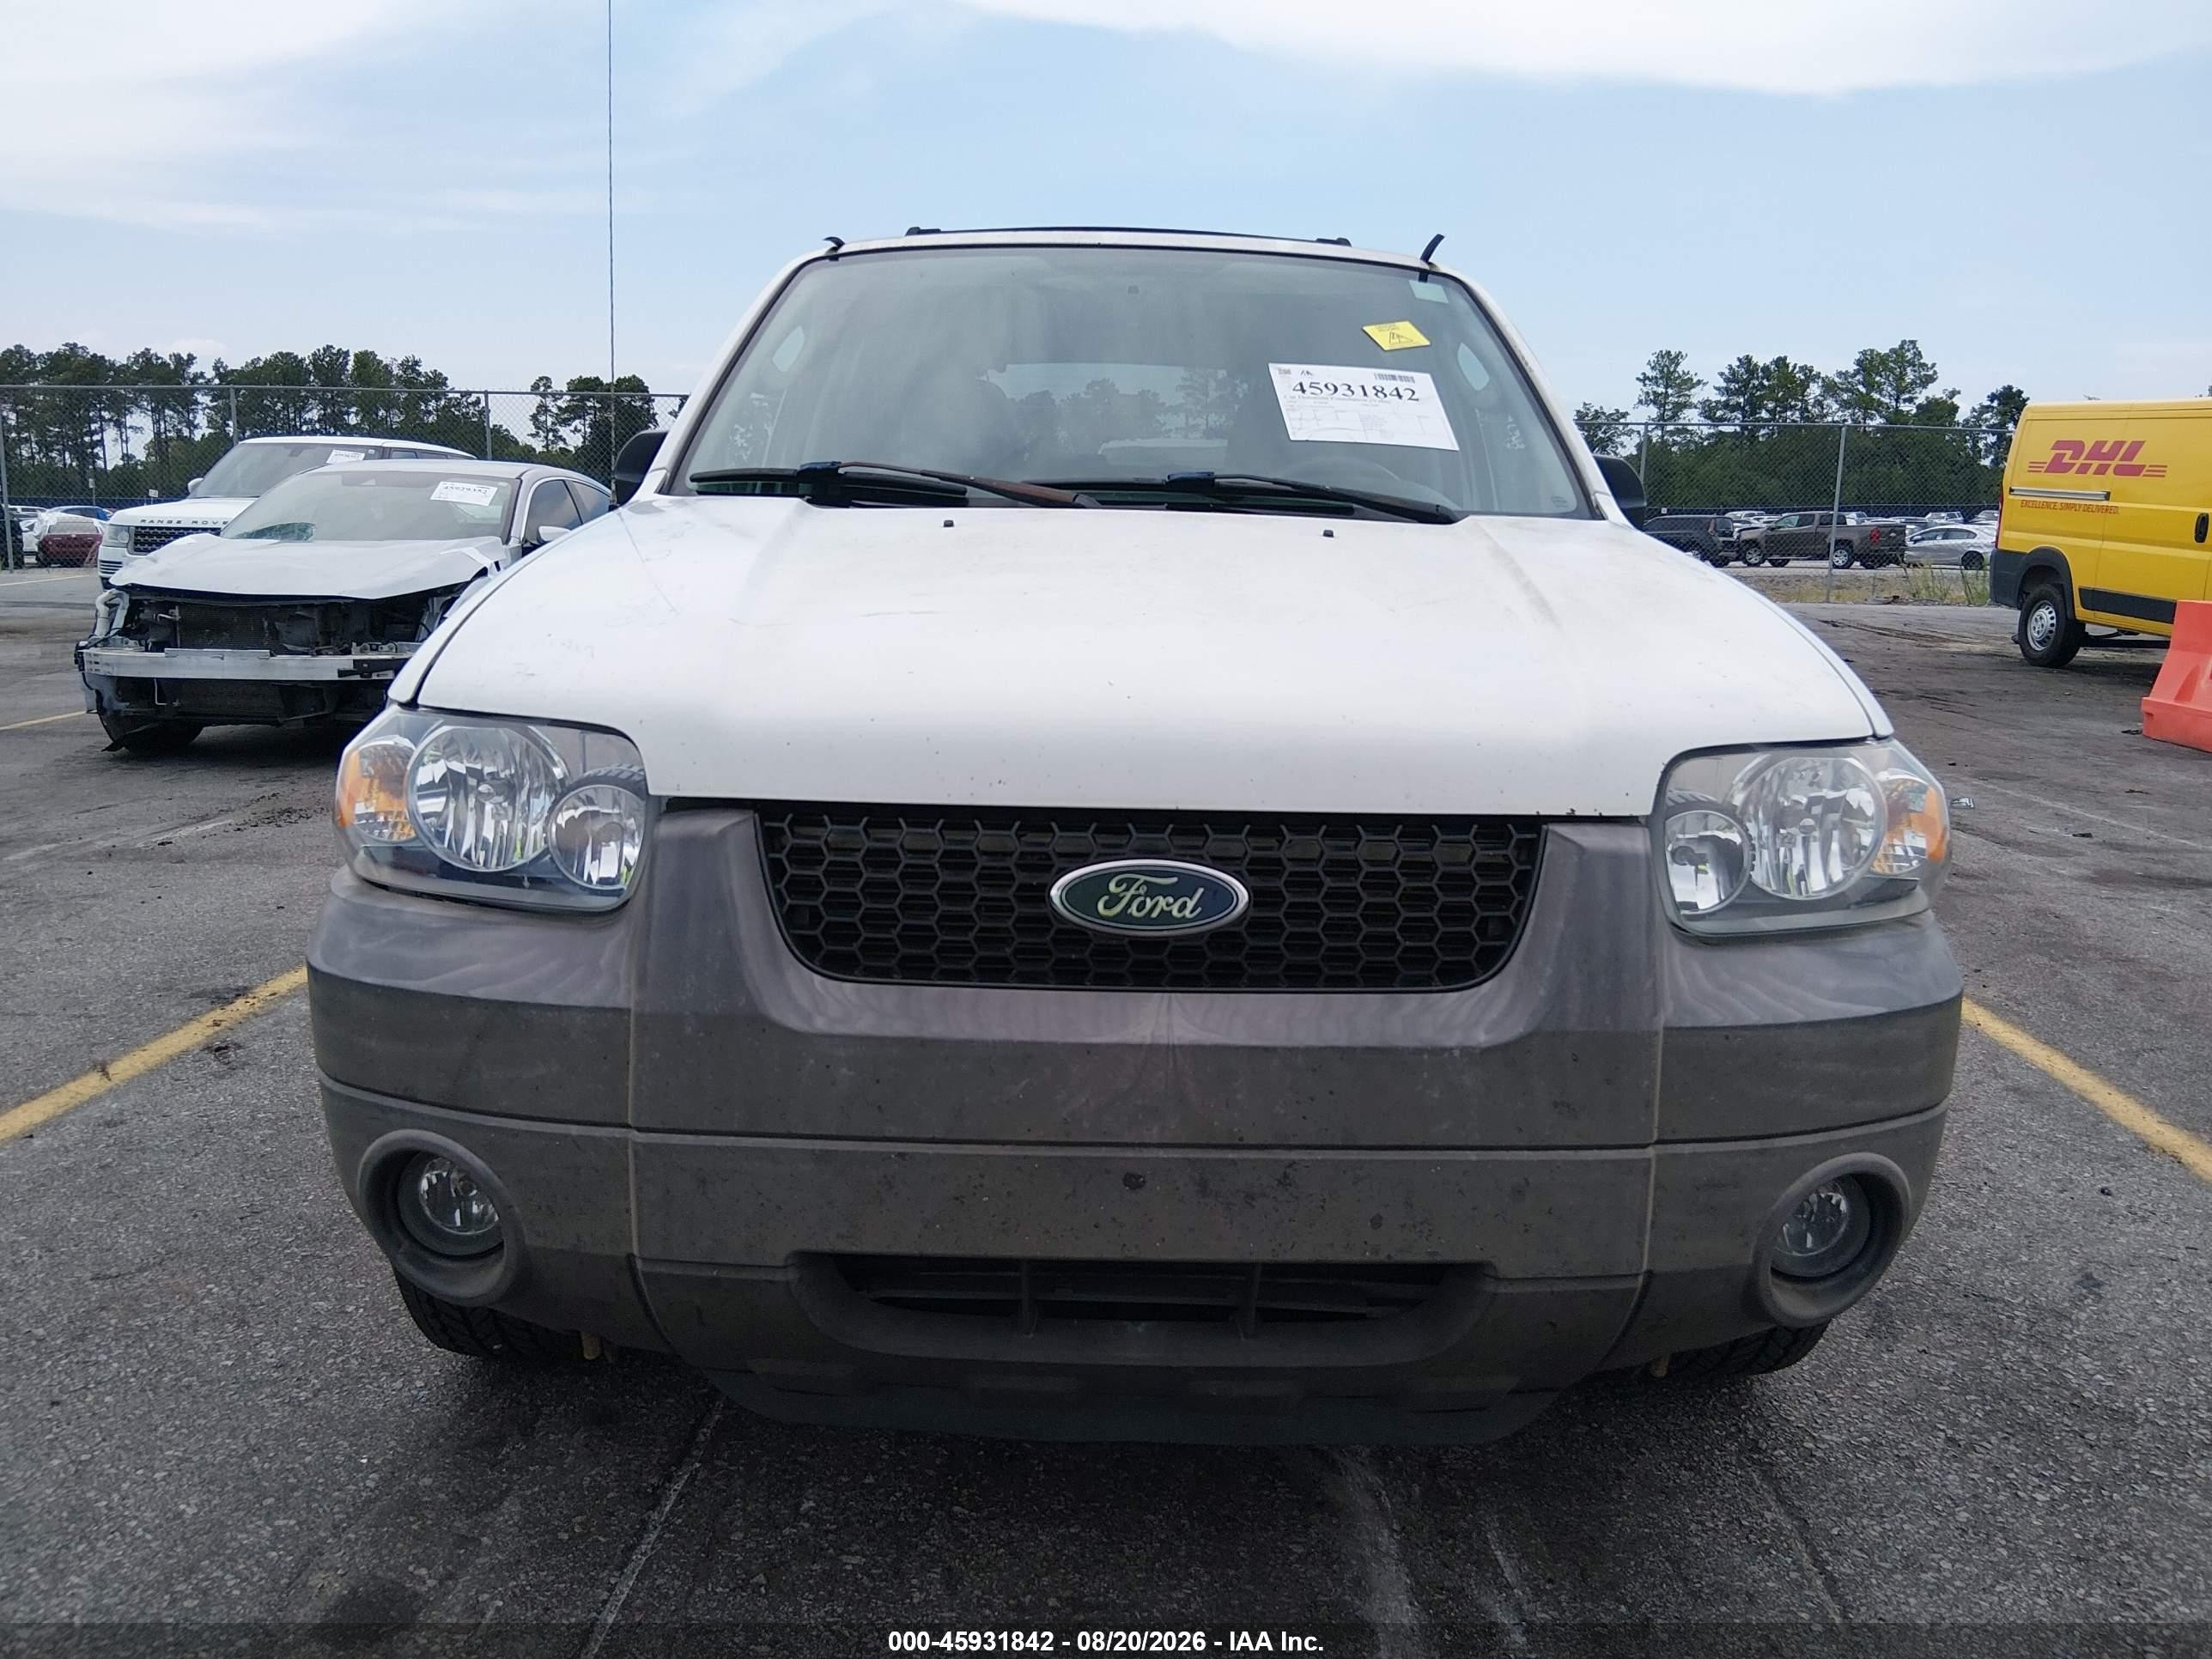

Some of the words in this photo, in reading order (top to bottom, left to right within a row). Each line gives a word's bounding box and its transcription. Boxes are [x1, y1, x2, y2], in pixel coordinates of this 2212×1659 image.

[1292, 381, 1419, 402] 45931842
[2043, 440, 2147, 477] DHL
[2059, 501, 2082, 513] SIMPLY
[1097, 873, 1205, 919] Ford
